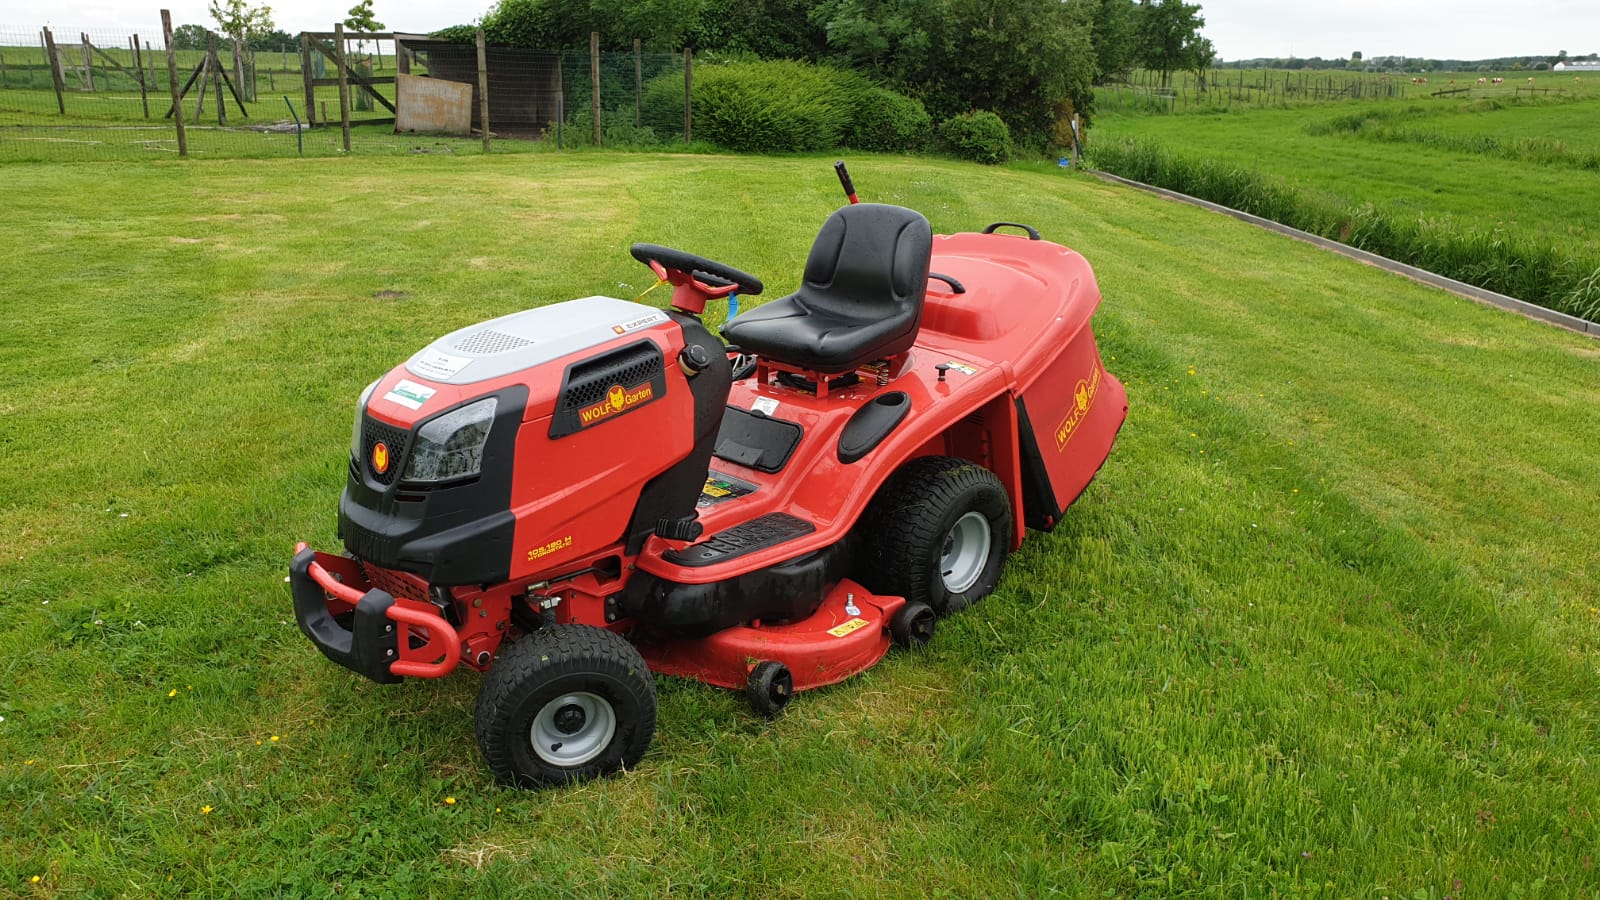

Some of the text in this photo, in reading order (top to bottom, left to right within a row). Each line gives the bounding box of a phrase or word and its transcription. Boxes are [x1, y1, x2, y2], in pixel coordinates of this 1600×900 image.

[626, 315, 658, 329] EXPERT
[582, 387, 652, 422] WOLF Garten
[1058, 407, 1079, 442] WOLF
